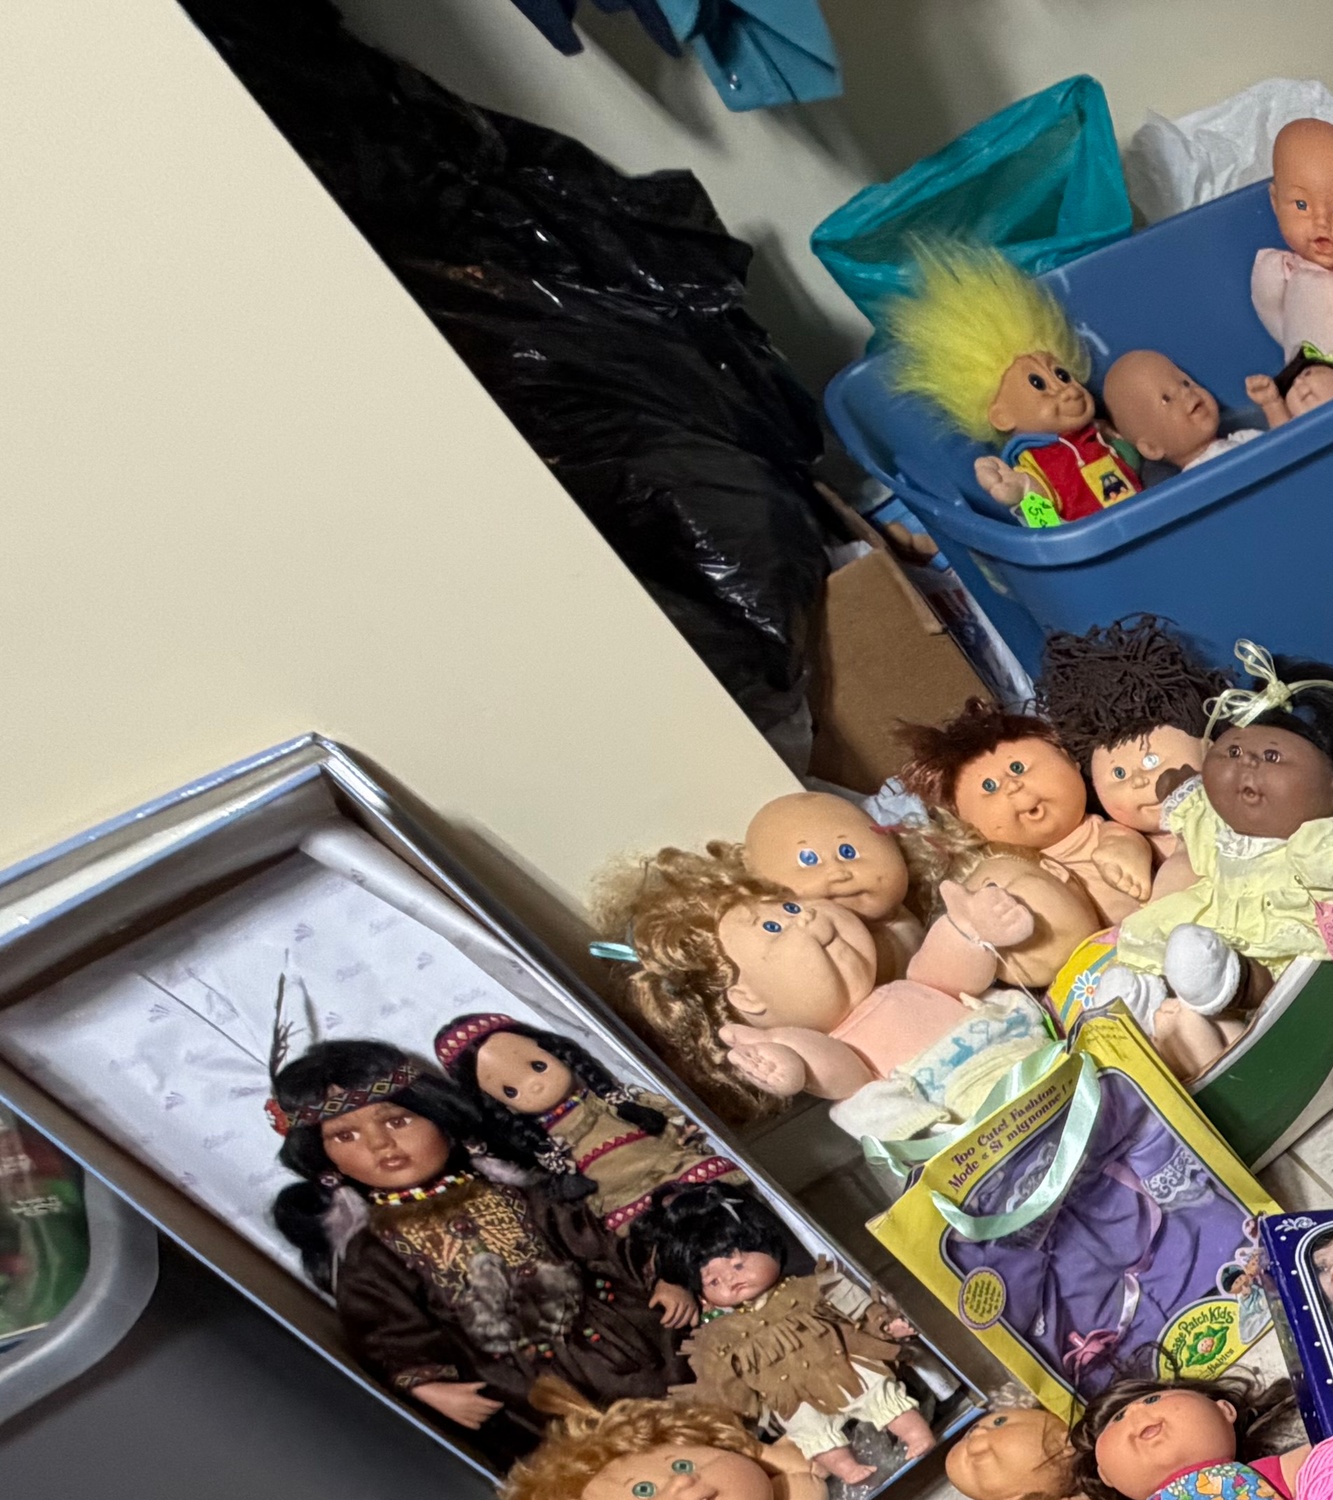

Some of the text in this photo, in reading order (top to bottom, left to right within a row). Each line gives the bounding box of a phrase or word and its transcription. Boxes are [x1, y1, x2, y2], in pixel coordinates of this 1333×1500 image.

[948, 1160, 980, 1193] Mode
[1006, 1093, 1062, 1142] mignonne
[952, 1085, 1057, 1167] Too Cute! Fashion
[1178, 1311, 1209, 1335] Patch
[1209, 1306, 1234, 1325] Kids
